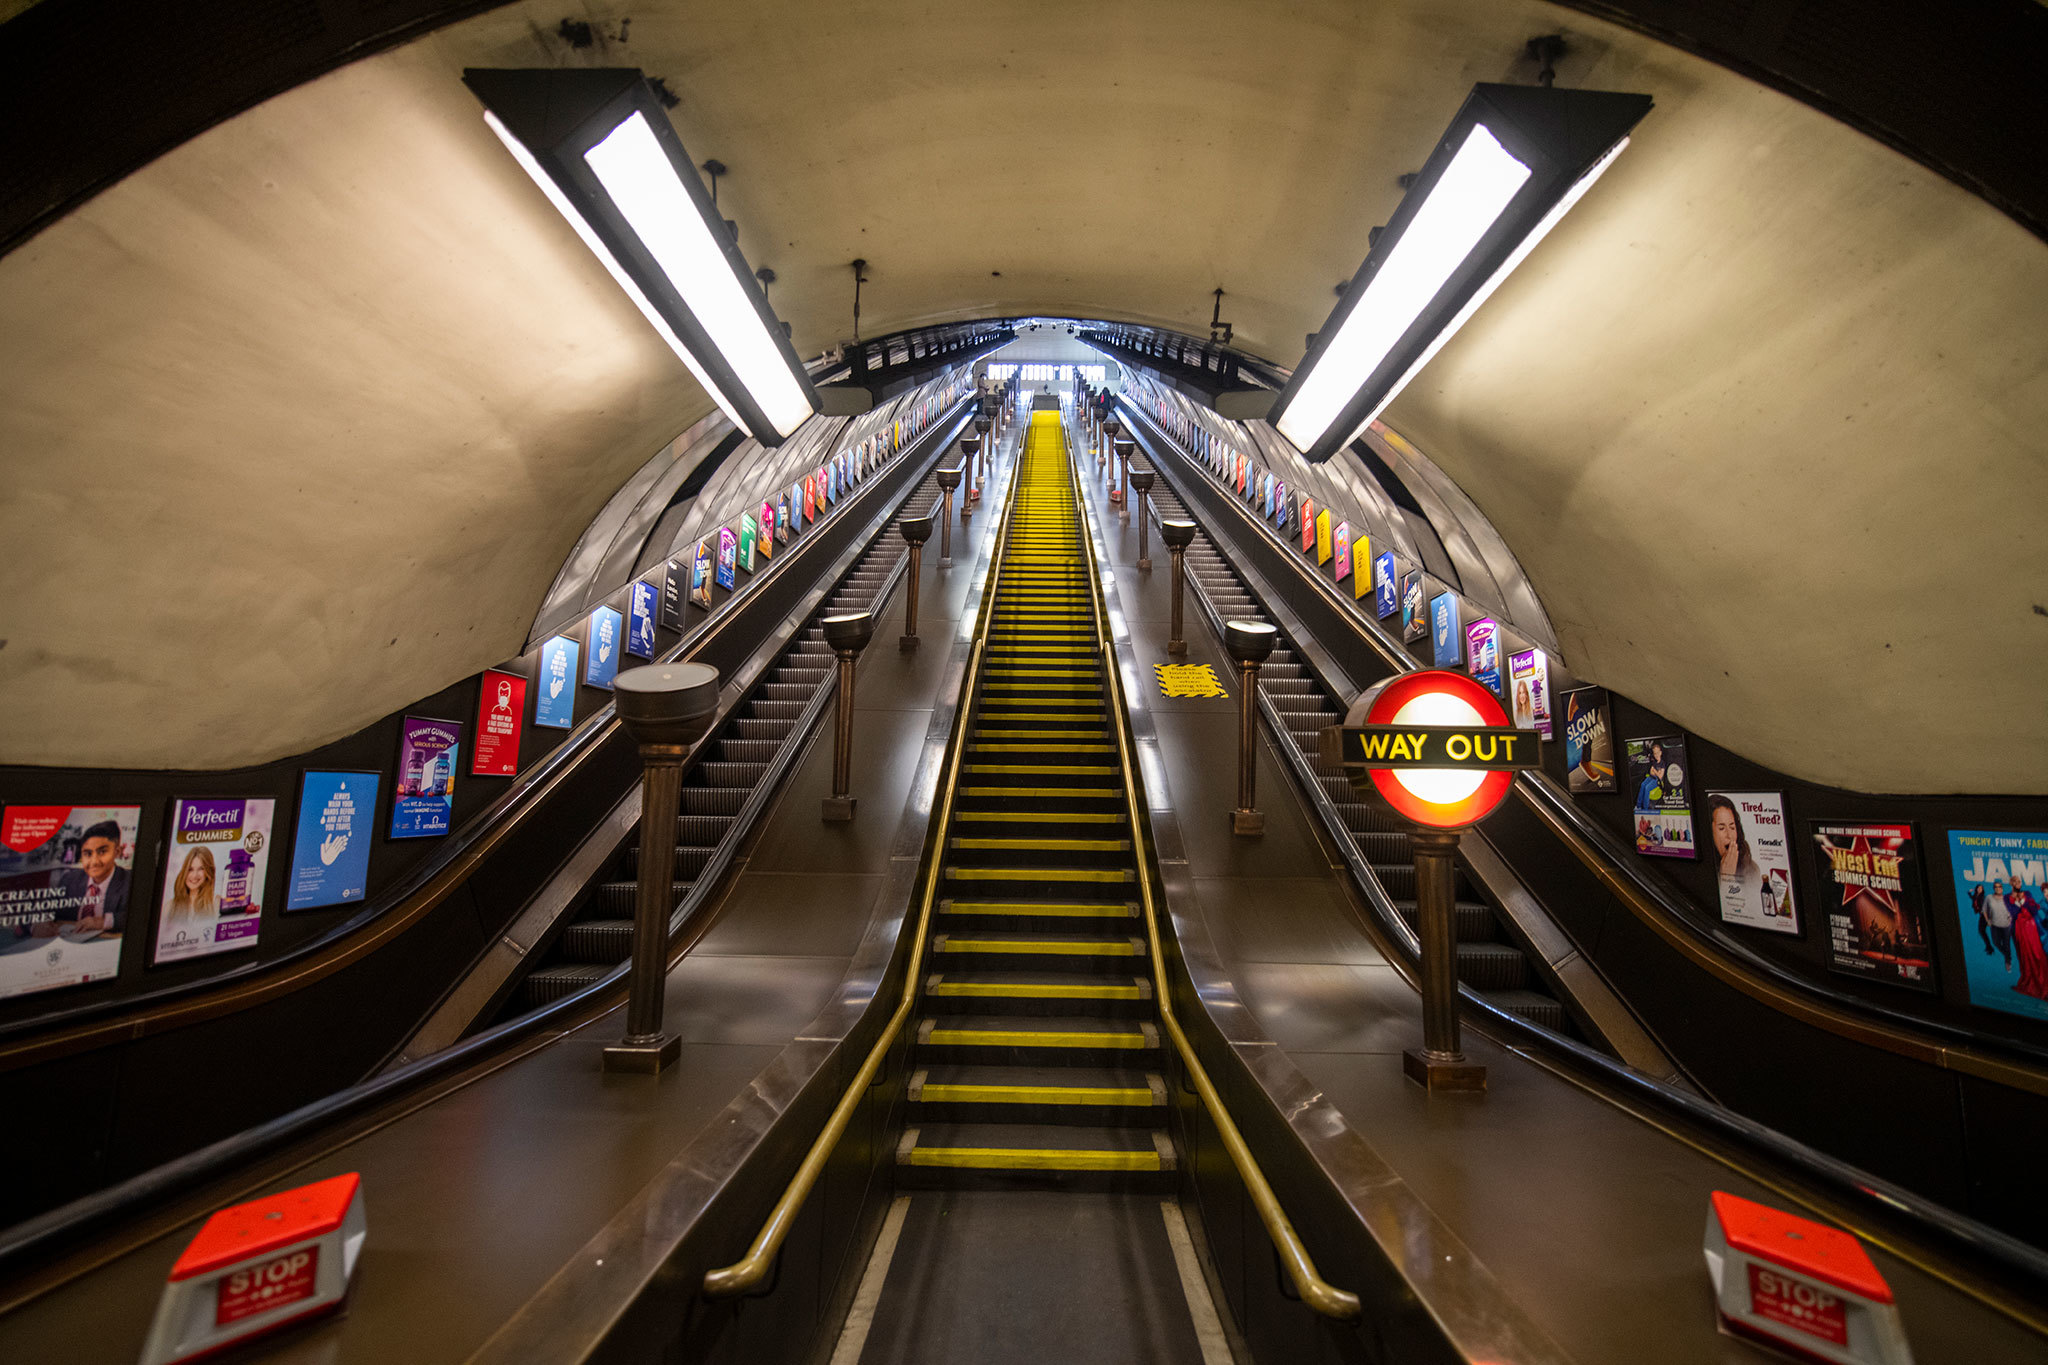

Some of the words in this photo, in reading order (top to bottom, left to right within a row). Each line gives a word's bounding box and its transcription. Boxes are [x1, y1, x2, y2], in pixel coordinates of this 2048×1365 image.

[409, 727, 431, 739] YUMMY
[431, 727, 455, 743] GUMMIES
[1567, 708, 1596, 741] SLOW
[1574, 721, 1606, 750] DOWN
[1360, 733, 1427, 760] WAY
[1445, 734, 1517, 761] OUT
[184, 805, 239, 829] Perfectil
[1741, 802, 1763, 812] Tired
[1754, 814, 1781, 825] Tired?
[186, 830, 234, 842] GUMMIES
[1995, 837, 2025, 849] FUNNY,
[1832, 849, 1870, 874] West
[1872, 855, 1900, 878] End
[1834, 870, 1868, 887] SUMMER
[1870, 875, 1903, 892] SCHOOL
[0, 887, 66, 901] CREATING
[229, 1253, 309, 1295] STOP
[1758, 1271, 1836, 1311] STOP
